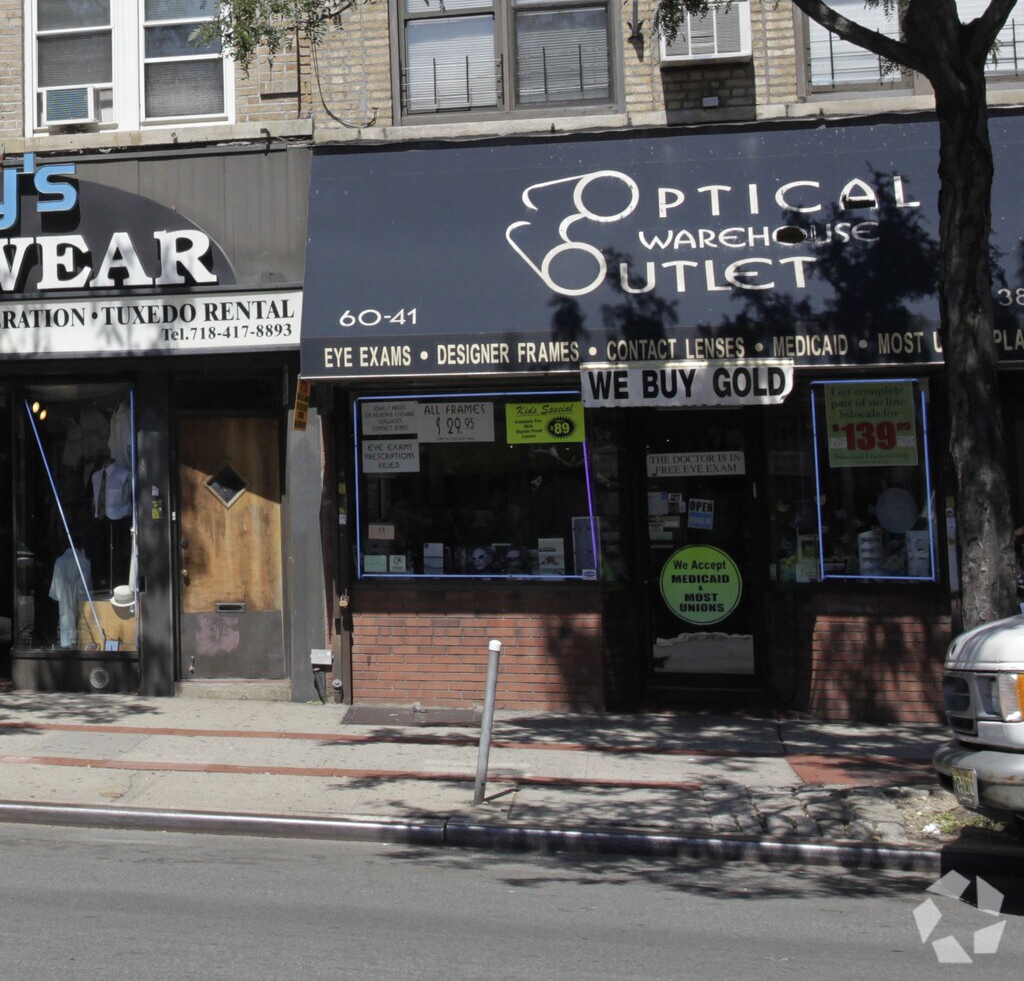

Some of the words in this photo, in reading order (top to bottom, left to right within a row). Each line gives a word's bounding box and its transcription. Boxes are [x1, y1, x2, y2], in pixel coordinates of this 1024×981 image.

[639, 221, 880, 250] WAREHOUSE
[101, 302, 196, 326] TUXEDO
[204, 299, 295, 322] RENTAL
[339, 308, 418, 327] 60-41
[324, 347, 353, 367] EYE
[359, 345, 411, 366] EXAMS
[437, 343, 509, 365] DESIGNER
[518, 341, 579, 363] FRAMES
[607, 338, 676, 361] CONTACT
[685, 337, 745, 358] LENSES
[773, 334, 848, 357] MEDICAID
[878, 332, 923, 354] MOST
[588, 370, 629, 399] WE
[642, 369, 697, 398] BUY
[712, 367, 786, 397] GOLD
[424, 405, 440, 415] ALL
[445, 403, 486, 415] FRAMES
[515, 405, 537, 415] Kids
[540, 404, 574, 416] Special
[831, 399, 852, 409] pair
[839, 409, 881, 419] bifocals
[883, 409, 899, 418] for
[367, 443, 383, 452] EYE
[387, 443, 413, 451] EXAMS
[365, 451, 415, 461] PRESCRIPTIONS
[649, 456, 670, 465] THE
[673, 454, 715, 464] DOCTOR
[718, 454, 727, 462] IS
[730, 453, 741, 462] IN
[656, 466, 680, 475] FREE
[683, 465, 704, 474] EYE
[706, 464, 737, 473] EXAM
[690, 501, 713, 513] OPEN
[673, 560, 688, 570] We
[691, 560, 726, 572] Accept
[671, 575, 730, 584] MEDICAID
[684, 593, 718, 602] MOST
[679, 603, 725, 612] UNIONS
